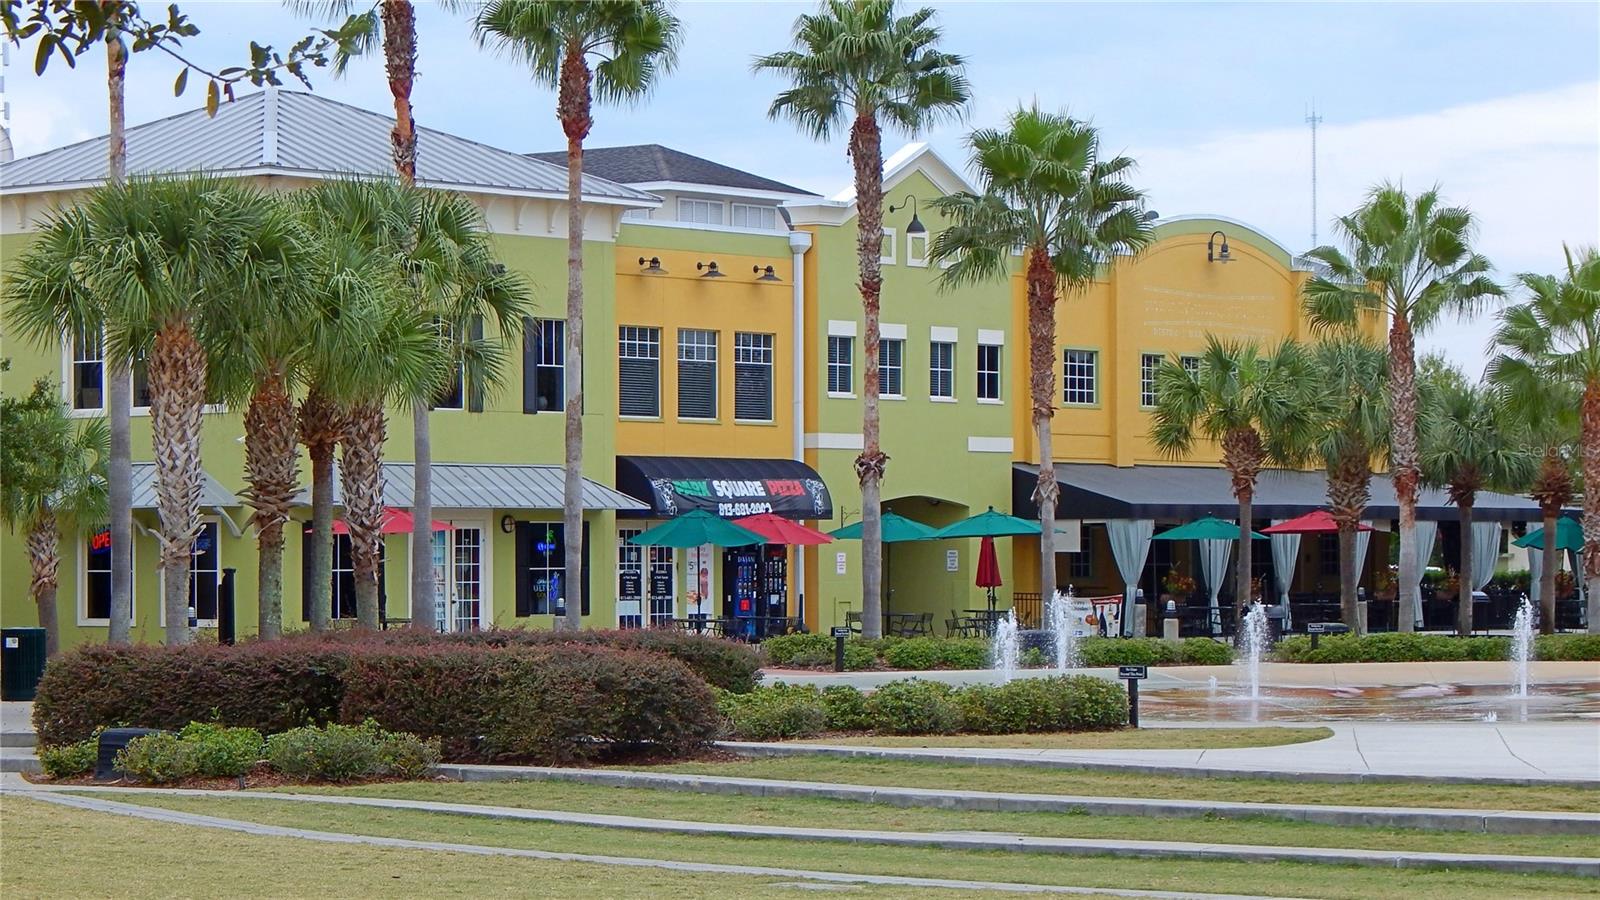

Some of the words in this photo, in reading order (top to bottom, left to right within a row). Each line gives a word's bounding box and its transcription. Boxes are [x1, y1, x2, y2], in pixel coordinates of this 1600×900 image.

[712, 480, 766, 499] SQUARE
[766, 480, 806, 496] PIZZA
[92, 532, 111, 550] OPE
